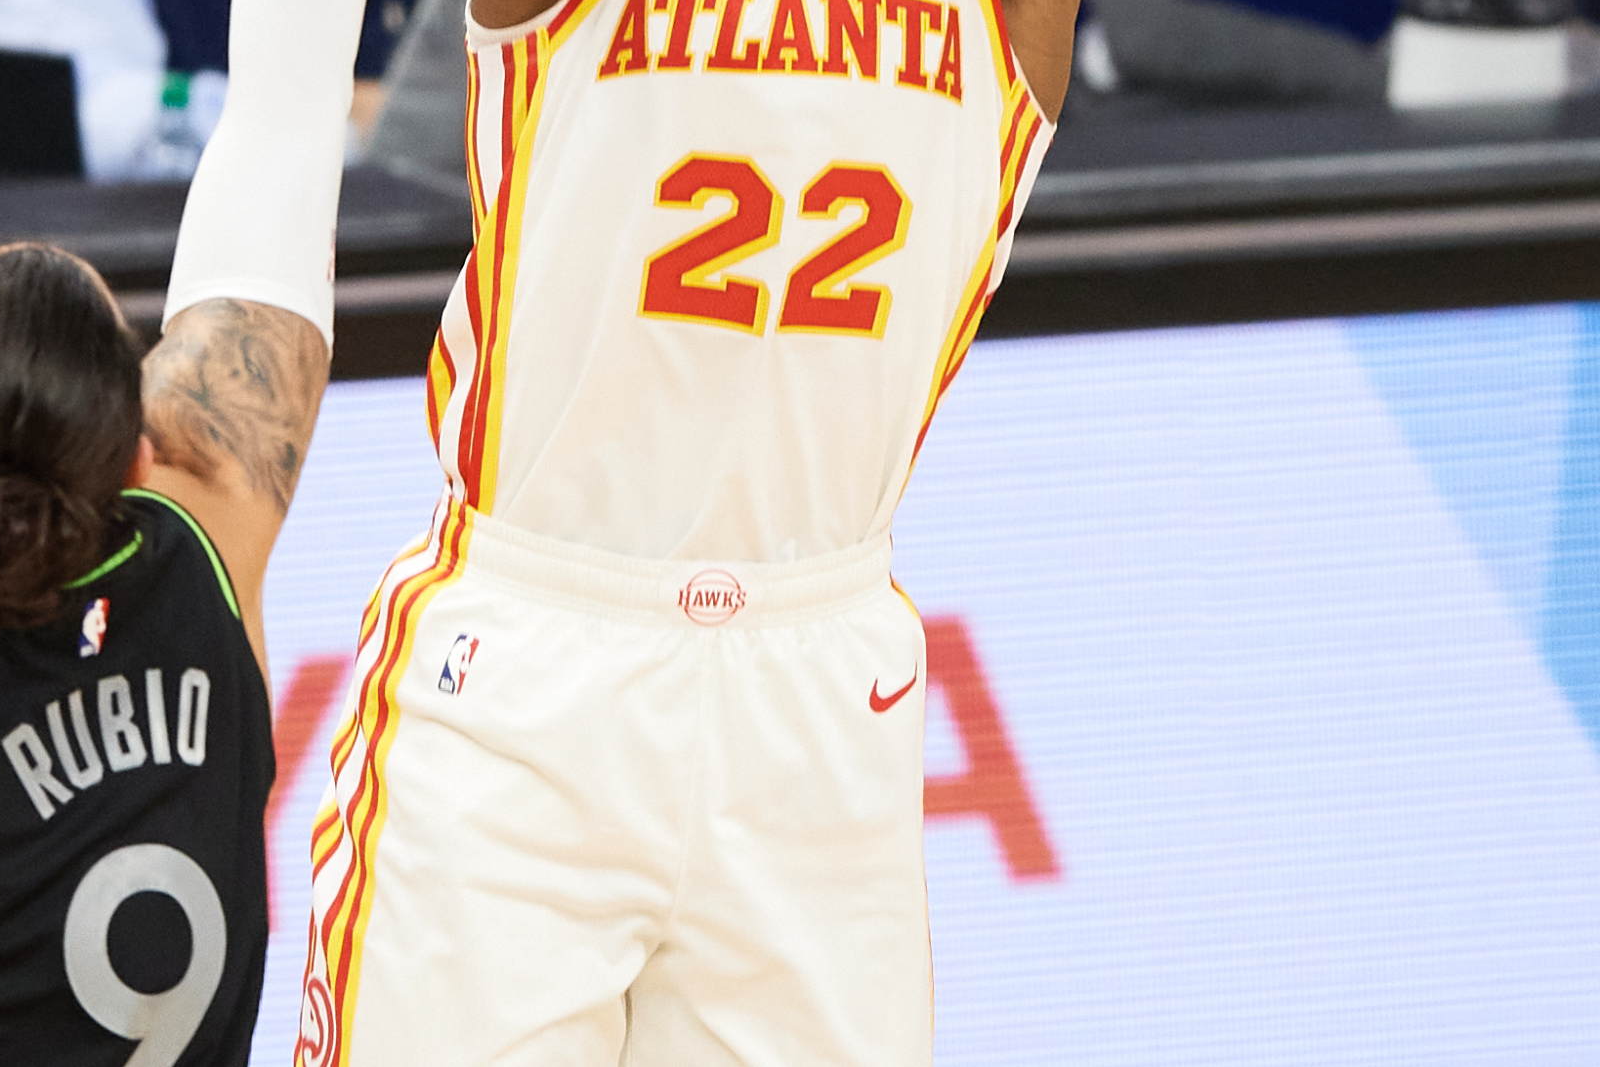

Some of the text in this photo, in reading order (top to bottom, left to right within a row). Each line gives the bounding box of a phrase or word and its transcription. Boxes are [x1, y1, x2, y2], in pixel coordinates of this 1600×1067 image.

[637, 150, 914, 339] 22
[678, 589, 746, 608] HAWKS
[1, 667, 211, 821] RUBIO
[63, 842, 227, 1067] 9
